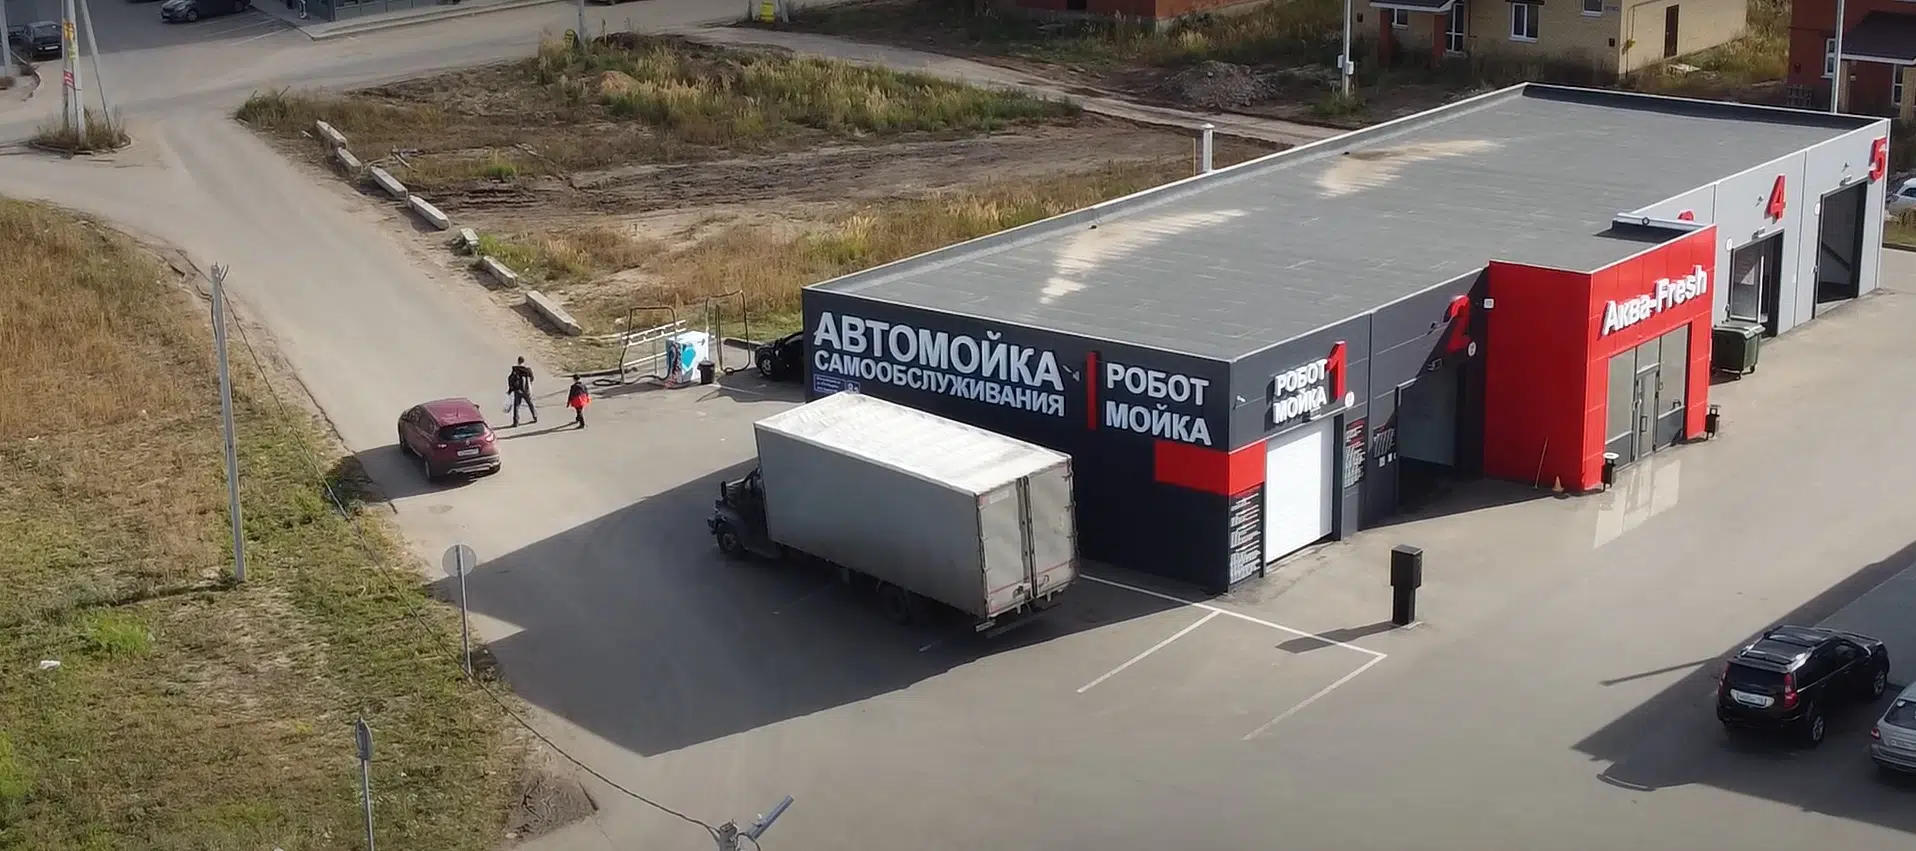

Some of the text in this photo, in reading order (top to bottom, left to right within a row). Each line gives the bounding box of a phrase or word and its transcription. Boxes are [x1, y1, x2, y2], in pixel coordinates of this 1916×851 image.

[1868, 134, 1886, 181] 5
[1764, 174, 1786, 221] 4
[1446, 294, 1471, 353] 2
[814, 311, 1064, 391] АВТОМОЙКА
[1326, 340, 1347, 403] 1
[814, 350, 1064, 417] САМООБСЛУЖИВАНИЯ
[1107, 362, 1210, 406] РОБОТ
[1275, 358, 1328, 397] РОБОТ
[1106, 400, 1212, 446] МОЙКА
[1273, 386, 1327, 424] МОЙКА
